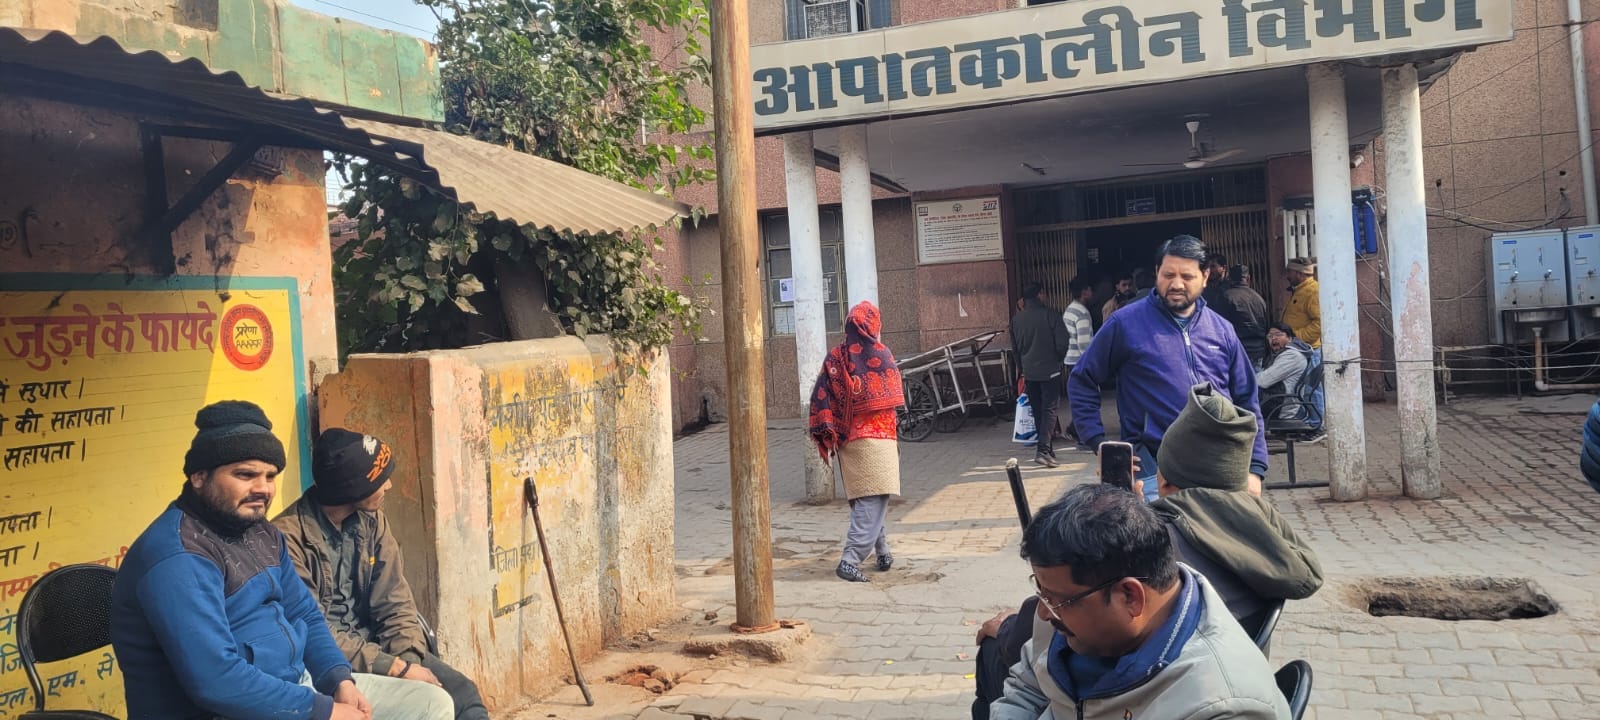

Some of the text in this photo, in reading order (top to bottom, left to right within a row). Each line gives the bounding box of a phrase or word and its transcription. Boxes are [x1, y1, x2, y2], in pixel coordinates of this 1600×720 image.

[753, 5, 1206, 116] आपातकालीन
[4, 303, 99, 372] जुड़ने
[101, 302, 135, 353] के
[137, 301, 217, 354] फायदे
[15, 408, 44, 433] की
[97, 652, 115, 680] से
